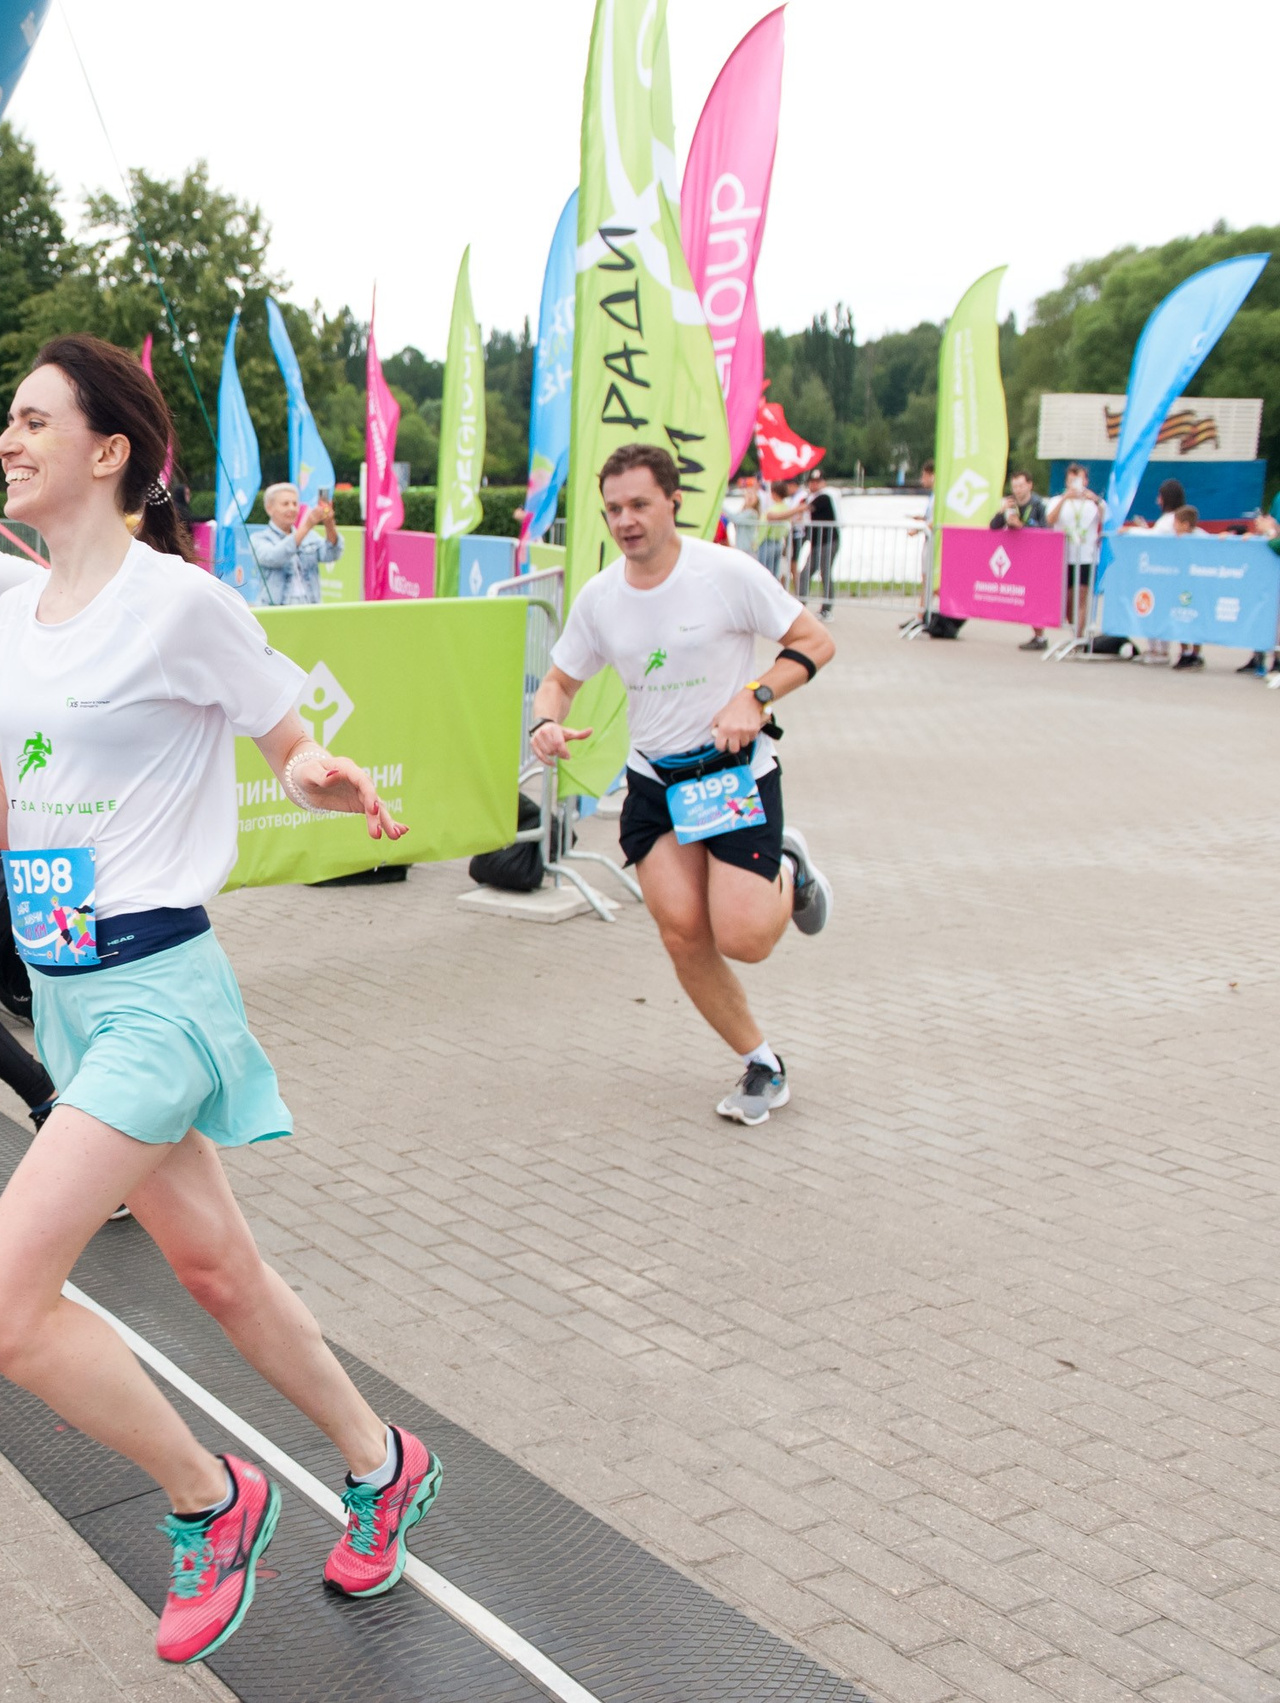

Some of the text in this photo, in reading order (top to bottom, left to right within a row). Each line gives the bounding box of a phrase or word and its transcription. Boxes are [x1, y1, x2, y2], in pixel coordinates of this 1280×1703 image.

[598, 228, 653, 429] РАДИ
[680, 773, 740, 805] 3199
[21, 801, 36, 812] ЗА
[10, 858, 73, 894] 3198
[107, 934, 135, 946] HEAD
